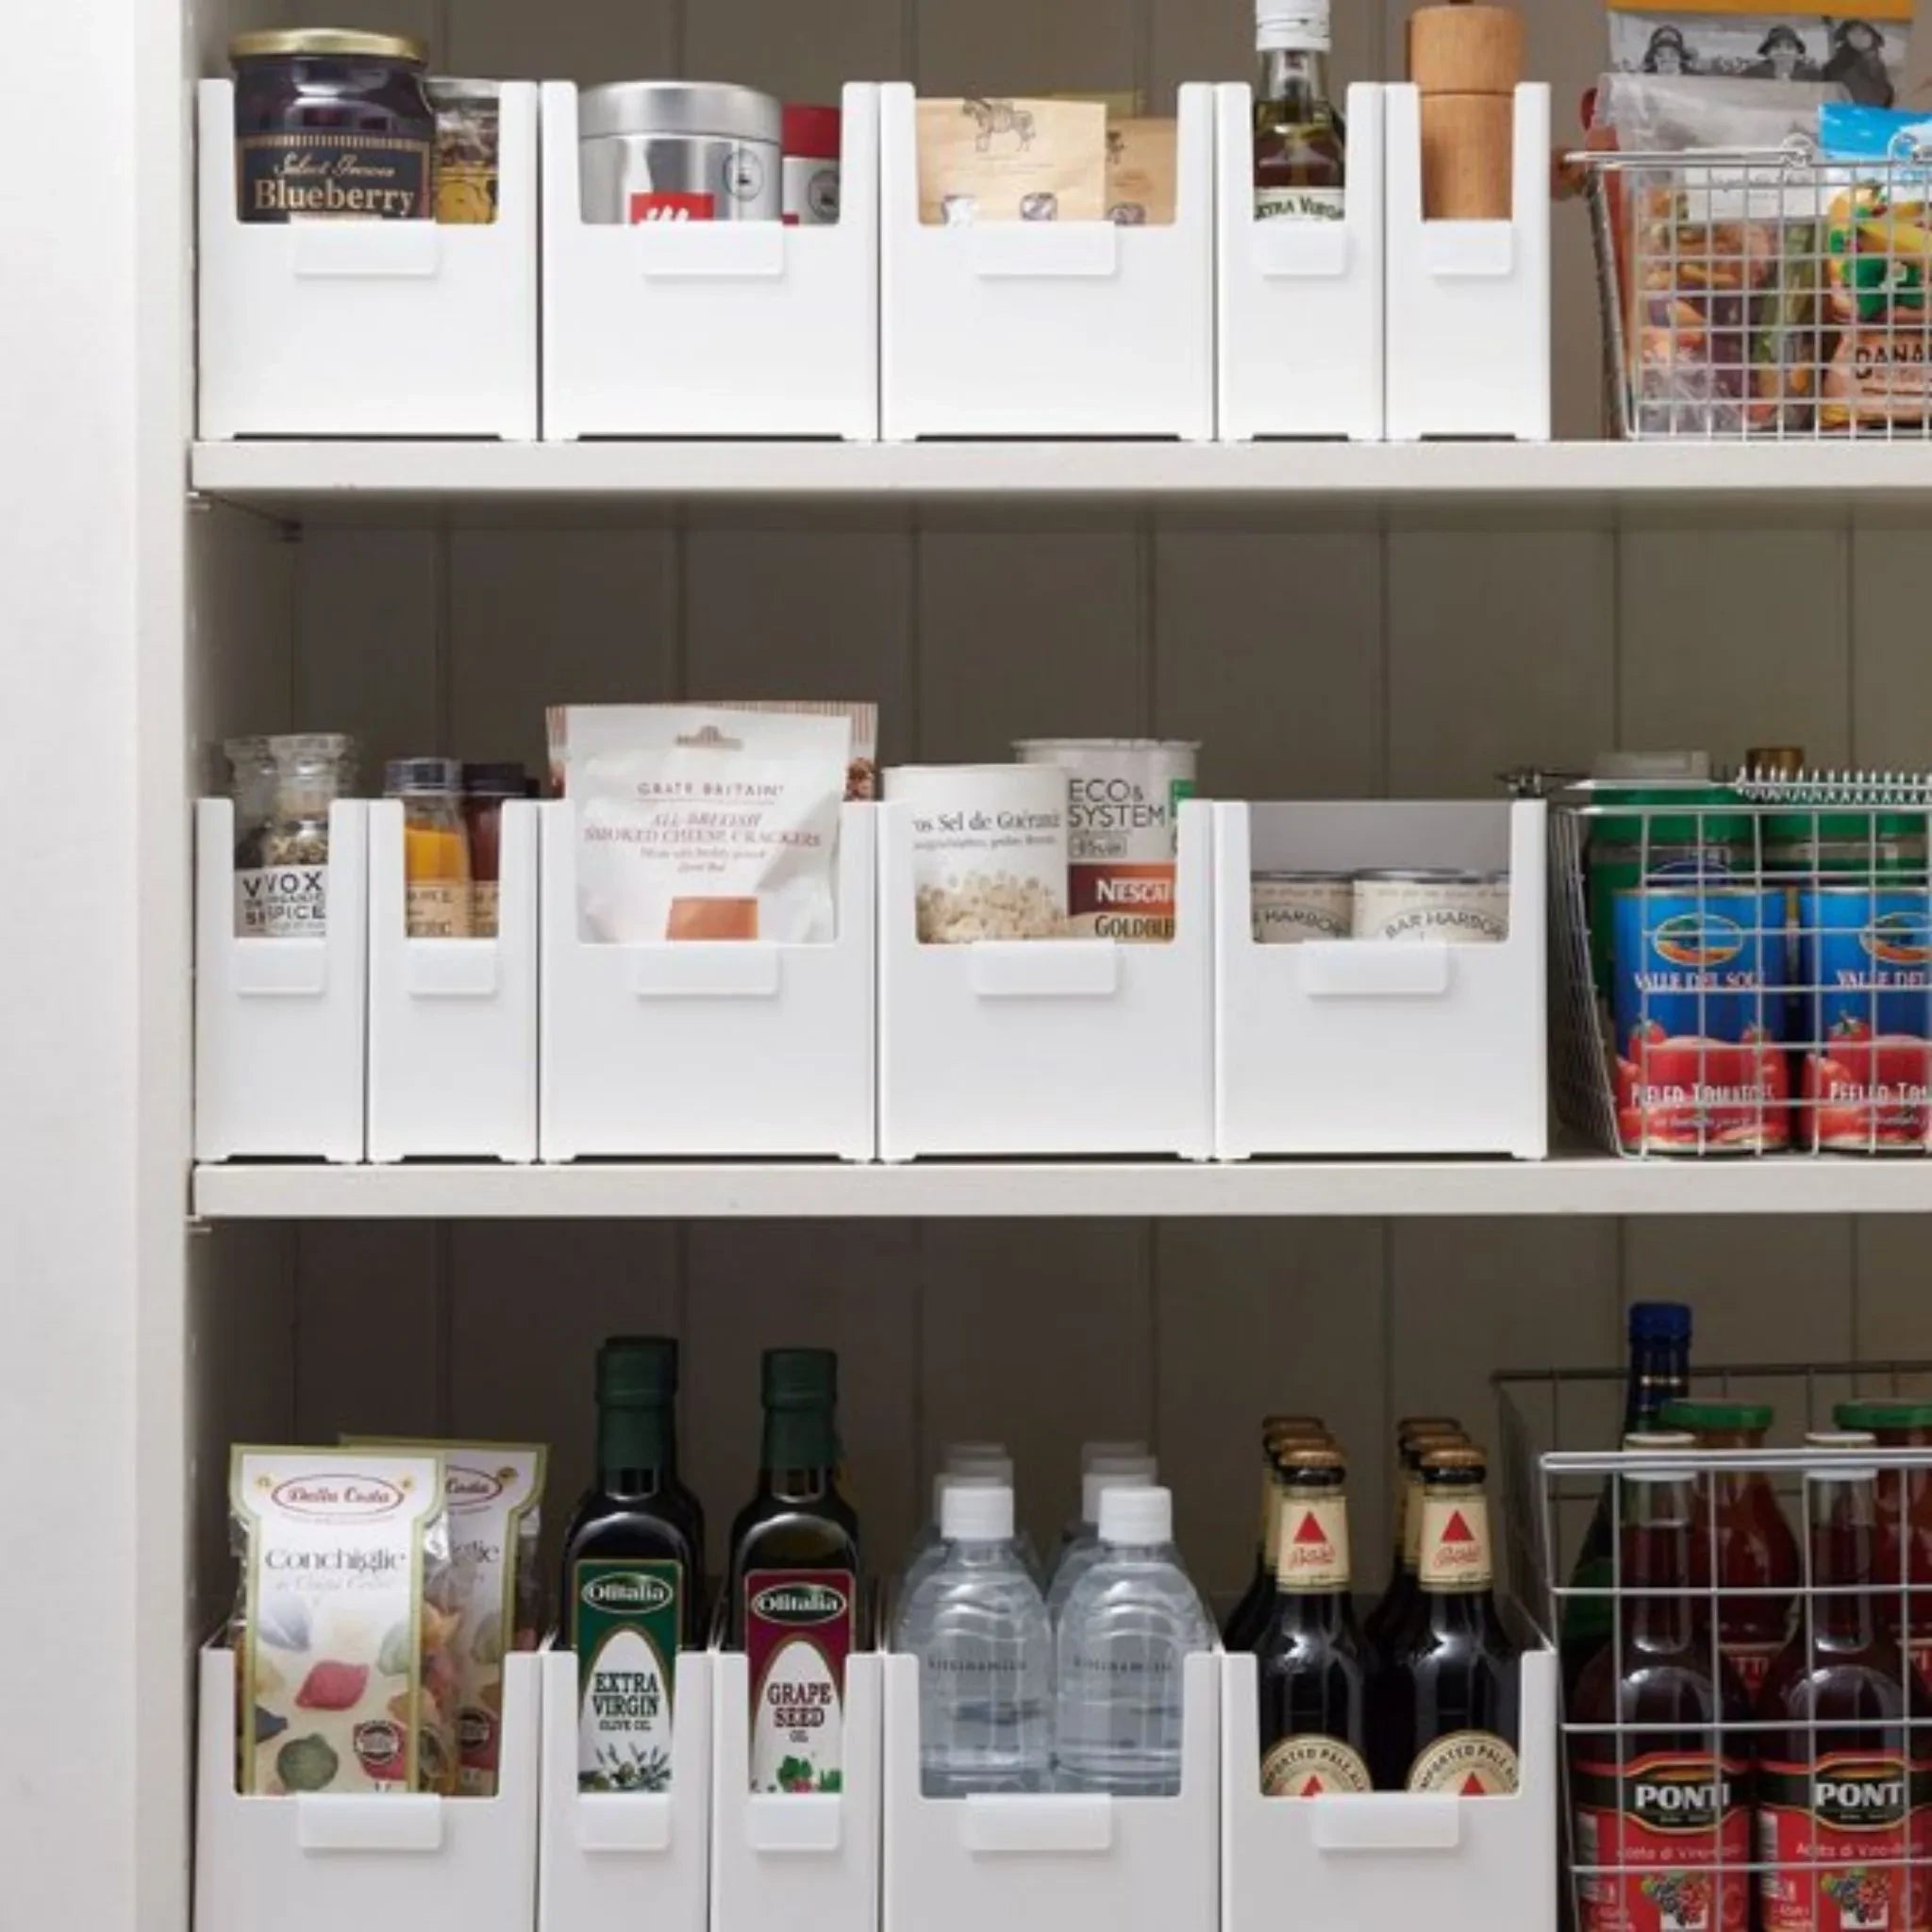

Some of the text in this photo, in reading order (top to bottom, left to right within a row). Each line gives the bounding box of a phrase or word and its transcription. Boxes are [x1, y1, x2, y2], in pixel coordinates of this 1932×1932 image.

[255, 178, 414, 216] Blueberry
[938, 811, 963, 831] Sel
[969, 810, 991, 830] de
[1068, 804, 1165, 827] SYSTEM
[1097, 878, 1173, 904] NESCAF
[595, 1673, 658, 1692] EXTRA
[767, 1682, 832, 1706] GRAPE
[592, 1694, 658, 1717] VIRGIN
[774, 1707, 824, 1728] SEED
[1635, 1782, 1730, 1810] PONTI
[1815, 1782, 1905, 1807] PONT
